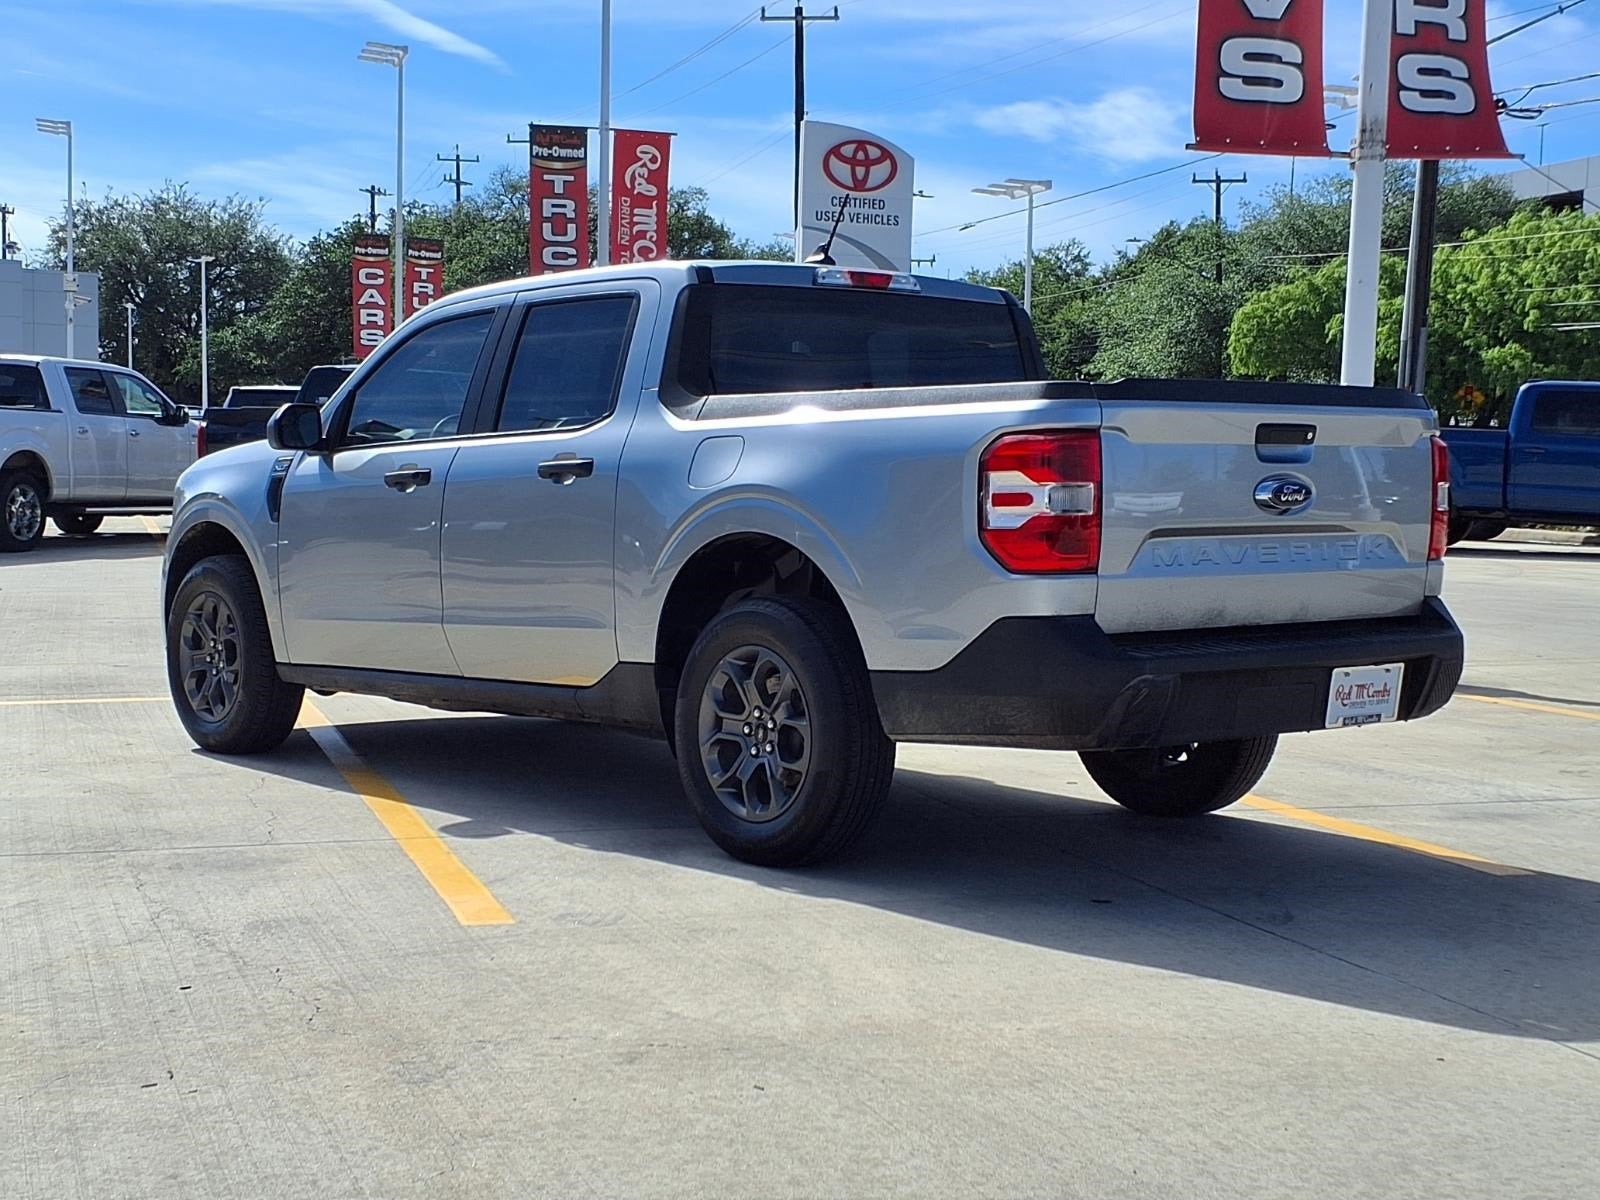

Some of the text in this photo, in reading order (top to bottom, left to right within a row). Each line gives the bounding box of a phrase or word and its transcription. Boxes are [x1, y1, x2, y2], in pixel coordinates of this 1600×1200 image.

[1395, 0, 1476, 115] RS
[532, 145, 585, 158] Pre-Owned
[624, 144, 662, 197] Red
[831, 195, 886, 211] CERTIFIED
[541, 174, 578, 275] TRUC
[620, 196, 631, 246] DRIVEN
[815, 210, 900, 227] USED VEHICLES
[357, 267, 386, 346] CARS
[1280, 485, 1306, 502] Ford
[1152, 540, 1386, 568] MAVERICK
[1335, 683, 1353, 707] Red
